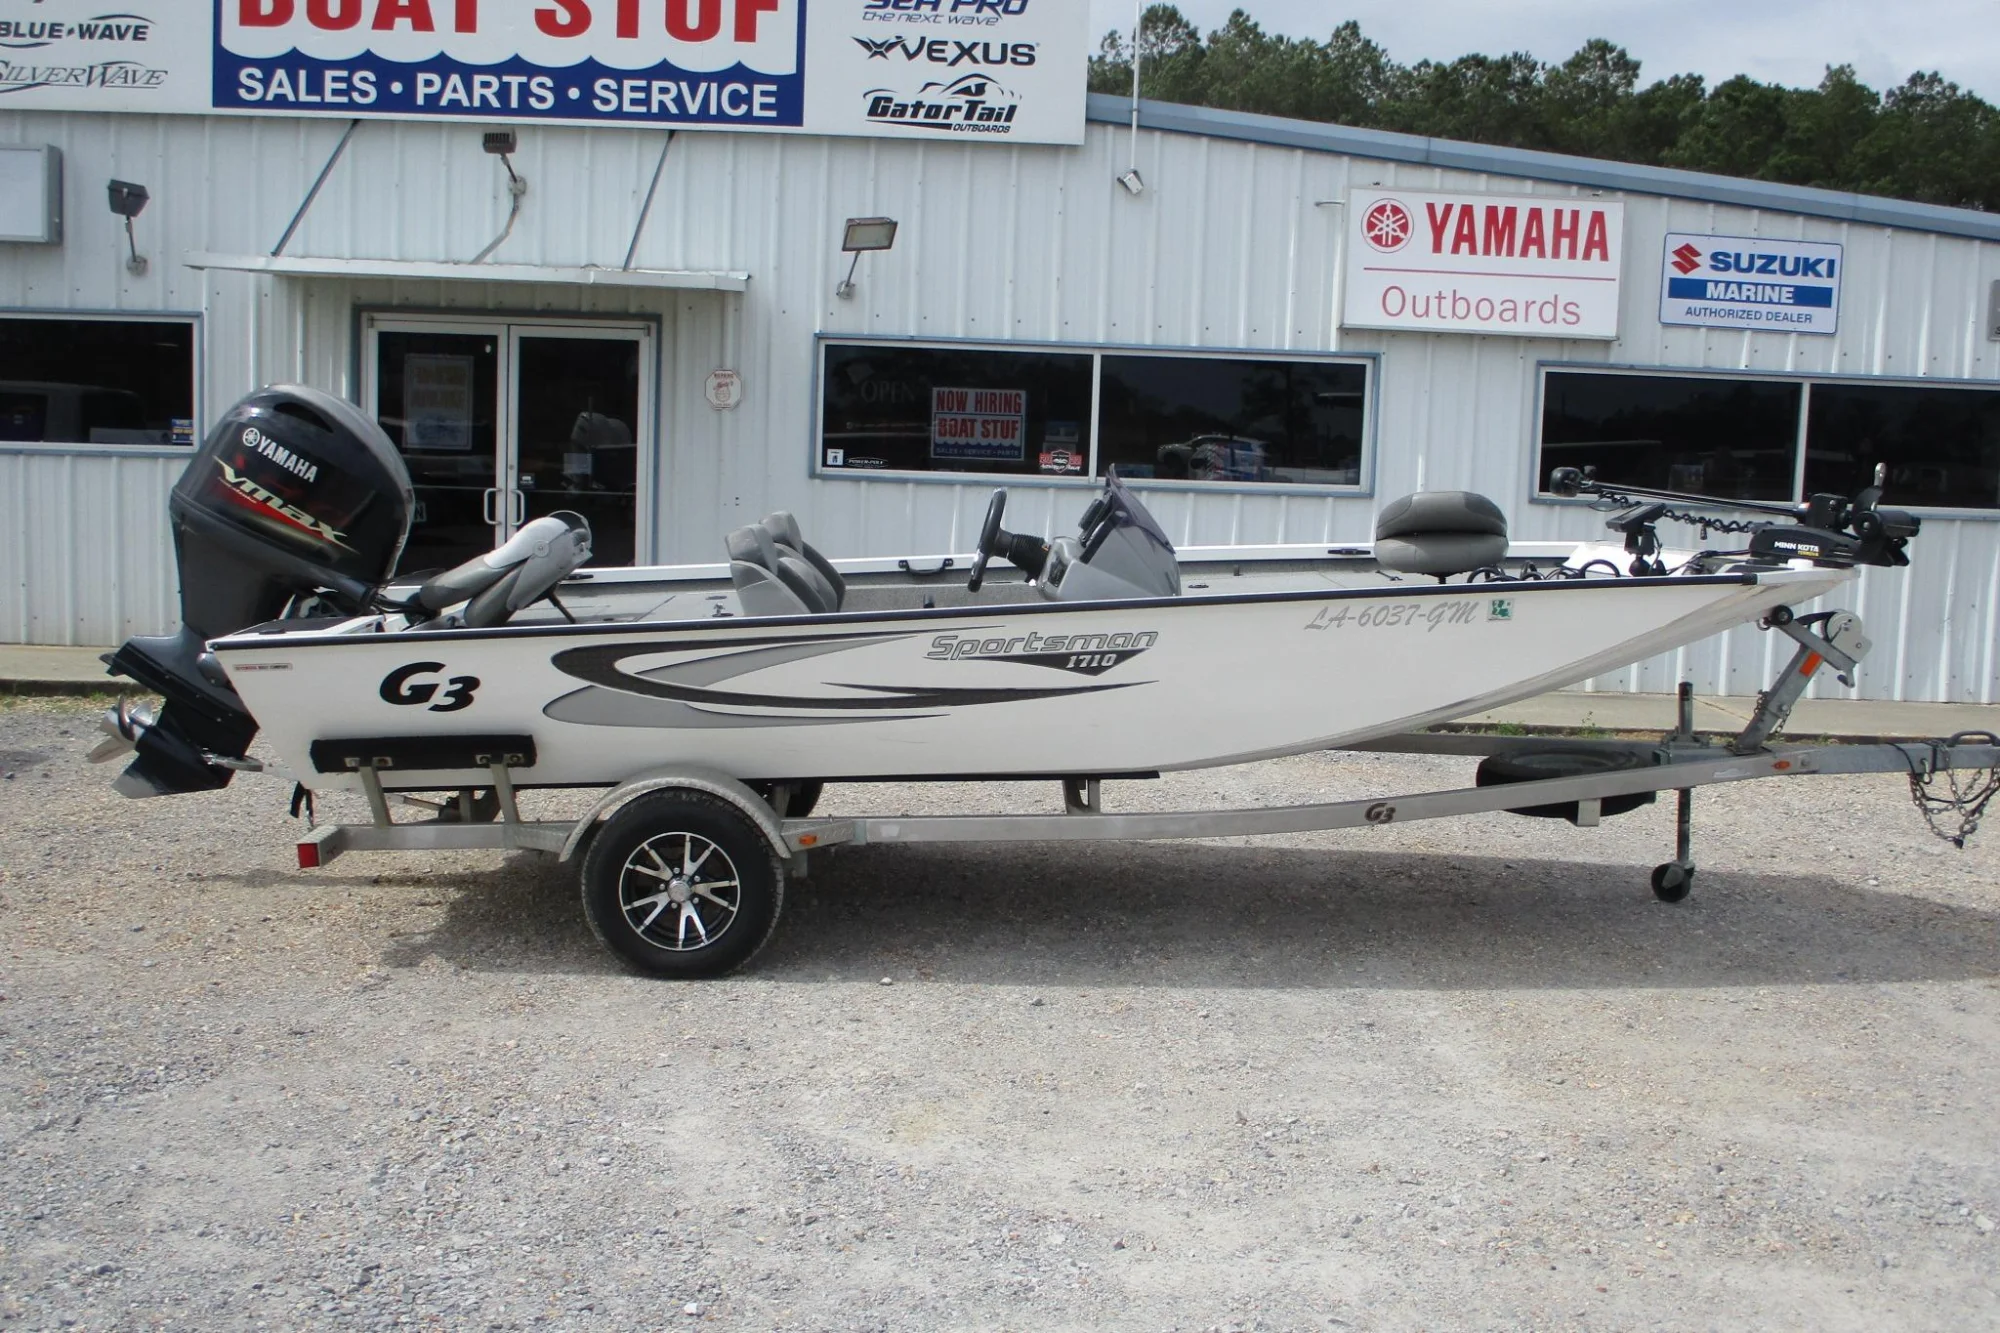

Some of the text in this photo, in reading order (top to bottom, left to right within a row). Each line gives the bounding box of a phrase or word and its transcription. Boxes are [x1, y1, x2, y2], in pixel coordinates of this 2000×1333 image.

[897, 13, 944, 24] next
[948, 15, 999, 26] wave
[897, 36, 1036, 67] VEXUS
[238, 67, 778, 118] SALES PARTS SERVICE
[952, 123, 1011, 134] OUTBOARDS
[1425, 202, 1609, 262] YAMAHA
[1709, 251, 1836, 279] SUZUKI
[1706, 281, 1796, 304] MARINE
[1381, 285, 1581, 326] Outboards
[1685, 306, 1813, 324] AUTHORIZED DEALER
[936, 390, 1022, 414] NOW HIRING
[938, 417, 1019, 439] BOAT STUF
[257, 435, 318, 483] YAMAHA
[1774, 541, 1819, 552] MINN KOTA
[927, 631, 1159, 661] Sportsman
[1066, 653, 1117, 669] 1710
[379, 661, 481, 712] G3
[1364, 802, 1396, 824] G3
